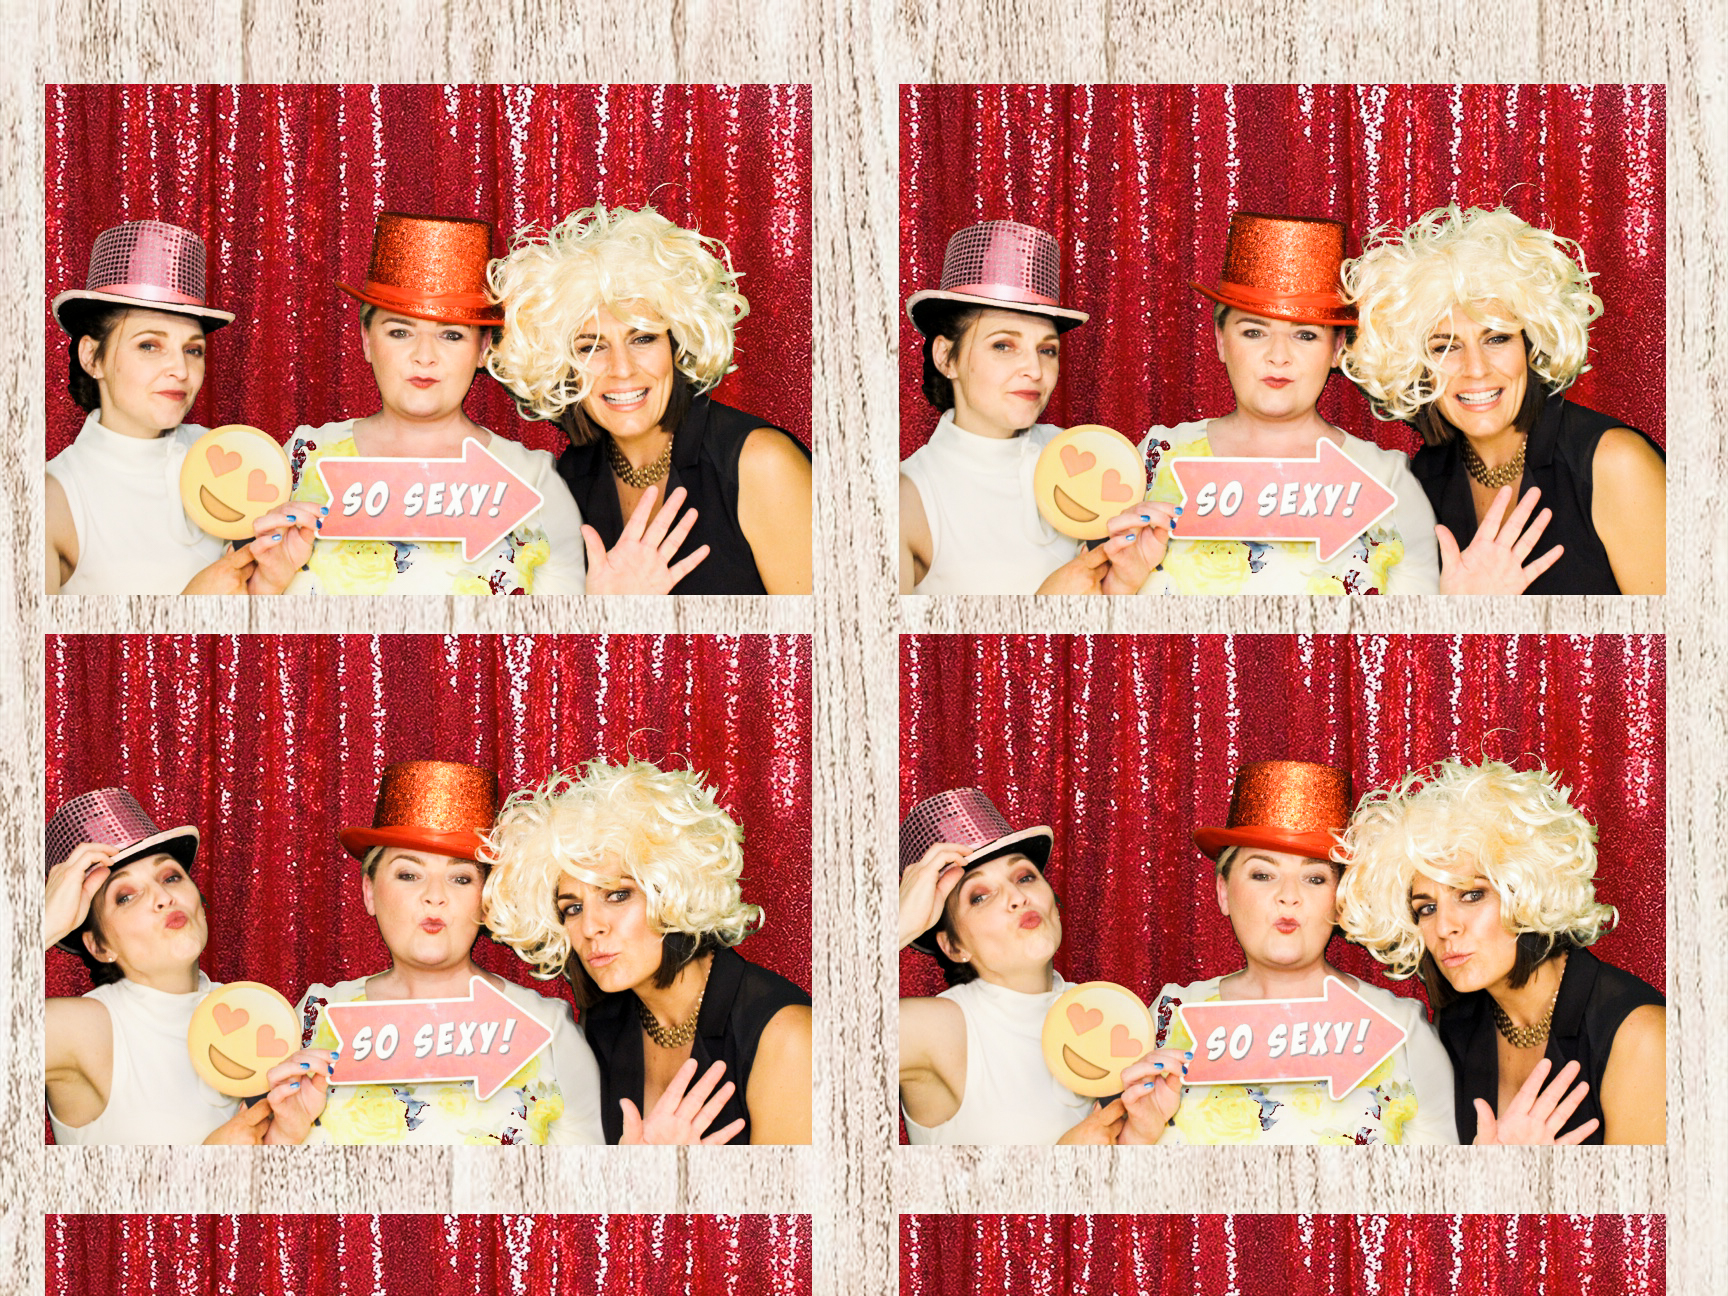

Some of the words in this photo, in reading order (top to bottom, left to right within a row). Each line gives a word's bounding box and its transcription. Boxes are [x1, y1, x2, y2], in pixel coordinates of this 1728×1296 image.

[342, 480, 390, 517] SO
[403, 481, 508, 518] SEXY!
[1196, 480, 1244, 517] SO
[1257, 481, 1362, 518] SEXY!
[352, 1024, 399, 1061] SO
[413, 1018, 517, 1059] SEXY!
[1206, 1024, 1253, 1061] SO
[1267, 1018, 1371, 1059] SEXY!
